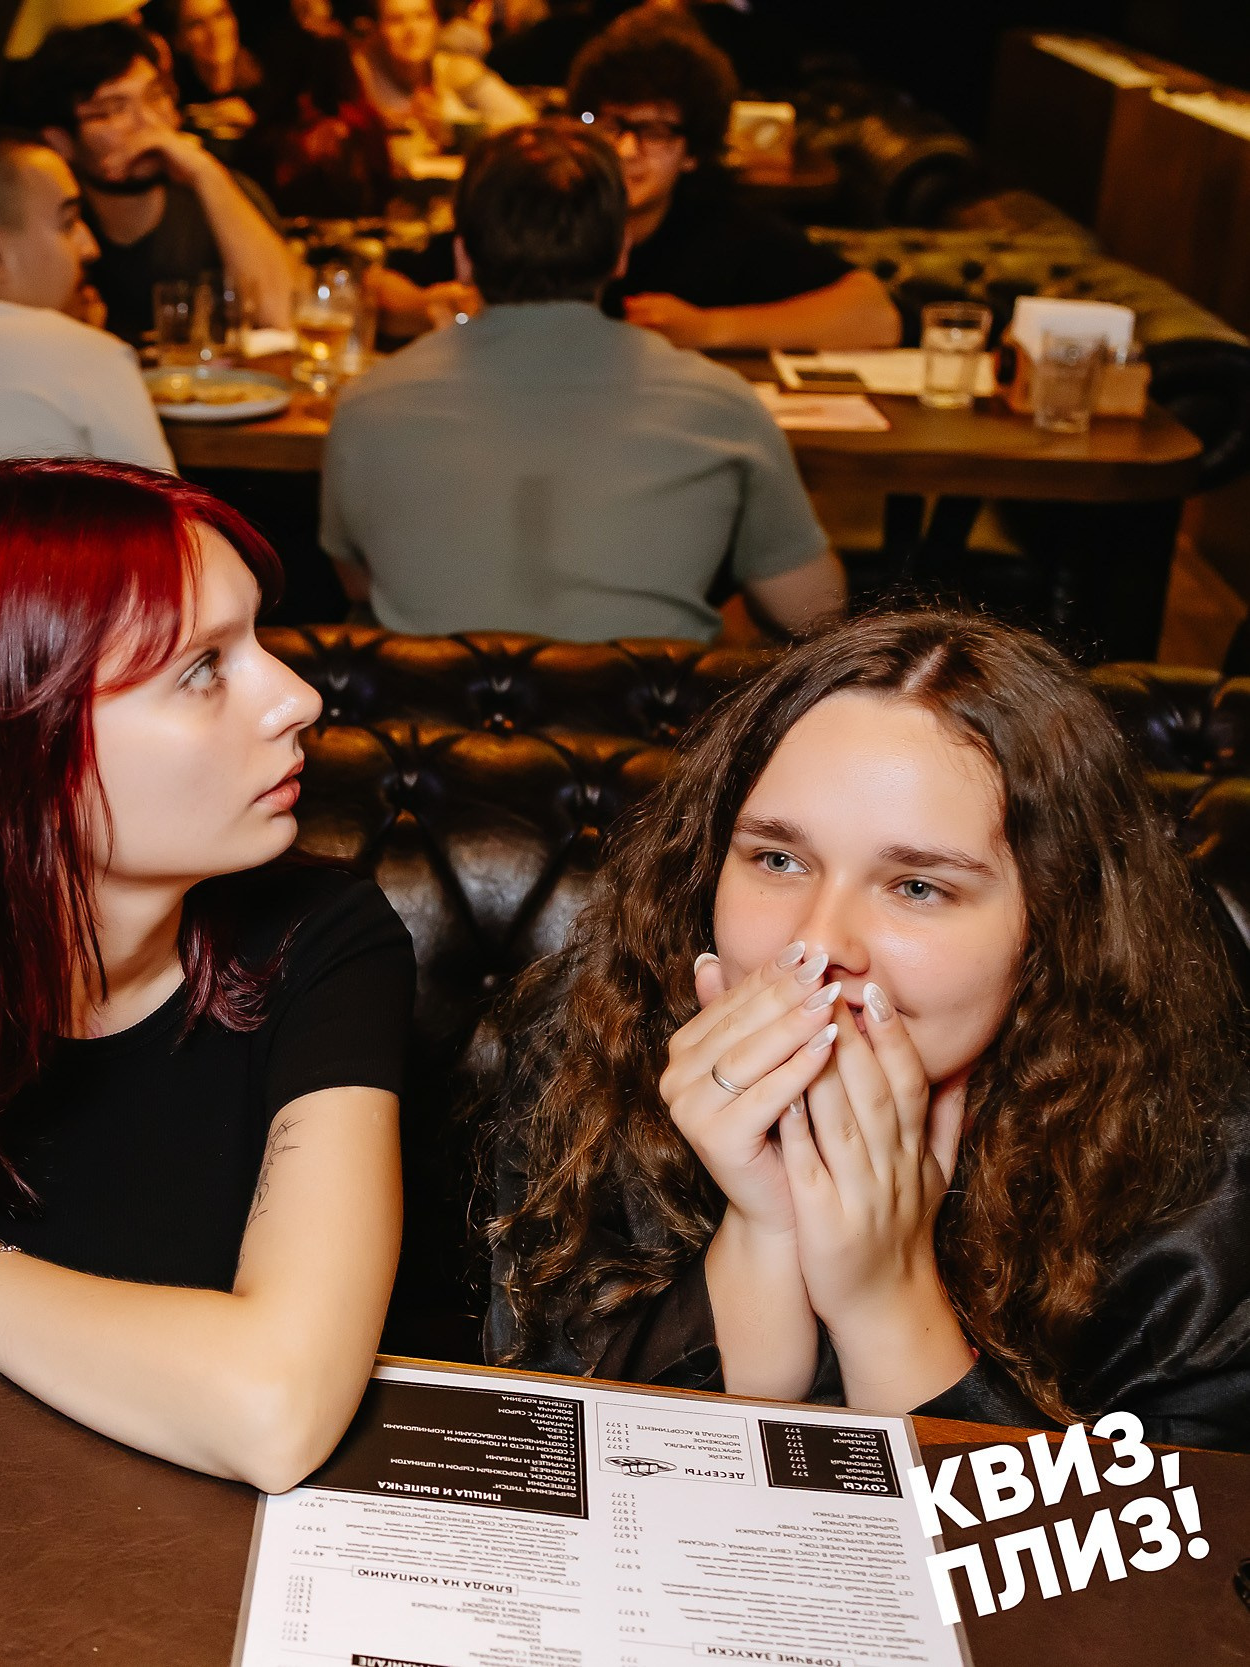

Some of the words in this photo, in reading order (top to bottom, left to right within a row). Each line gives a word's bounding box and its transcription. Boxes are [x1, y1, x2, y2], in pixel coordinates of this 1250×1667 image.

[500, 1395, 537, 1403] КОРЗИНА
[538, 1399, 573, 1408] ХЛЕБНАЯ
[497, 1407, 526, 1415] СЫРОМ
[536, 1405, 573, 1415] ФОКАЧЧА
[533, 1411, 573, 1421] ХАЧАПУРИ
[529, 1418, 574, 1428] МАРГАРИТА
[605, 1420, 621, 1428] 577
[382, 1423, 445, 1434] КОРНИШОНАМИ
[536, 1425, 567, 1434] СЕЗОНА
[636, 1424, 693, 1435] АССОРТИМЕНТЕ
[454, 1430, 507, 1440] КОЛБАСКАМИ
[546, 1433, 568, 1441] СЫРА
[700, 1430, 739, 1439] ШОКОЛАД
[837, 1431, 875, 1439] СМЕТАНА
[443, 1435, 500, 1446] ПОМИДОРАМИ
[507, 1435, 568, 1448] ОХОТНИЧЬИМИ
[692, 1437, 740, 1446] МОРОЖЕНОЕ
[786, 1440, 803, 1448] 577
[832, 1438, 877, 1446] ДЗАДЗЫКИ
[508, 1442, 535, 1450] ПЕСТО
[535, 1445, 568, 1454] СОУСОМ
[663, 1441, 696, 1450] ТАРЕЛКА
[697, 1445, 742, 1454] ФРУКТОВАЯ
[484, 1453, 522, 1463] ГРИБАМИ
[539, 1453, 575, 1462] ГРИБНАЯ
[707, 1453, 743, 1461] ЧИЗКЕЙК
[848, 1453, 880, 1461] ТАР-ТАР
[389, 1457, 436, 1467] ШПИНАТОМ
[531, 1459, 569, 1468] КУРИЦЕЙ
[829, 1459, 882, 1468] СЛИВОЧНЫЙ
[444, 1463, 475, 1472] СЫРОМ
[475, 1466, 528, 1478] ТВОРОЖНЫМ
[529, 1465, 576, 1476] БОЛОНЬЕЗЕ
[845, 1467, 884, 1475] ГРИБНОЙ
[528, 1472, 569, 1483] ЛОСОСЕМ,
[684, 1467, 744, 1479] ДЕСЕРТЫ
[834, 1473, 886, 1483] ГОРЧИЧНЫЙ
[377, 1480, 439, 1494] ВЫПЕЧКА
[526, 1479, 576, 1491] ПЕППЕРОНИ
[842, 1481, 888, 1492] СОУСЫ
[442, 1487, 452, 1496] И
[454, 1488, 501, 1501] ПИЦЦА
[525, 1486, 576, 1498] ФИРМЕННАЯ
[610, 1491, 627, 1499] 277
[362, 1507, 431, 1519] ПРИГОТОВЛЕНИЯ
[811, 1511, 844, 1519] ГРЕНКИ
[432, 1514, 495, 1526] СОБСТВЕННОГО
[846, 1513, 897, 1523] ЧЕСНОЧНЫЕ
[497, 1521, 540, 1531] КОЛБАСОК
[612, 1523, 630, 1531] 977
[776, 1523, 799, 1531] ПИВУ
[820, 1519, 861, 1528] ПАЛОЧКИ
[863, 1522, 899, 1531] СЫРНЫЕ
[541, 1527, 578, 1536] АССОРТИ
[734, 1528, 781, 1537] ДЗАДЗЫКИ
[807, 1526, 854, 1535] ОХОТНИКА
[855, 1531, 901, 1539] КОЛБАСКИ
[782, 1532, 817, 1540] СОУСОМ
[825, 1536, 875, 1545] ЧЕБУРЕЧКИ
[677, 1539, 719, 1547] ЧИПСАМИ
[490, 1545, 540, 1556] ШАШЛЫКОВ
[793, 1549, 820, 1557] СОУСЕ
[541, 1551, 579, 1561] АССОРТИ
[828, 1552, 864, 1560] КРЫЛЬЯ
[866, 1556, 907, 1564] КУРИНЫЕ
[357, 1568, 437, 1584] КОМПАНИЮ
[441, 1578, 459, 1587] НА
[463, 1580, 512, 1593] БЛЮДА
[707, 1646, 770, 1660] ЗАКУСКИ
[777, 1653, 841, 1667] ГОРЯЧИЕ
